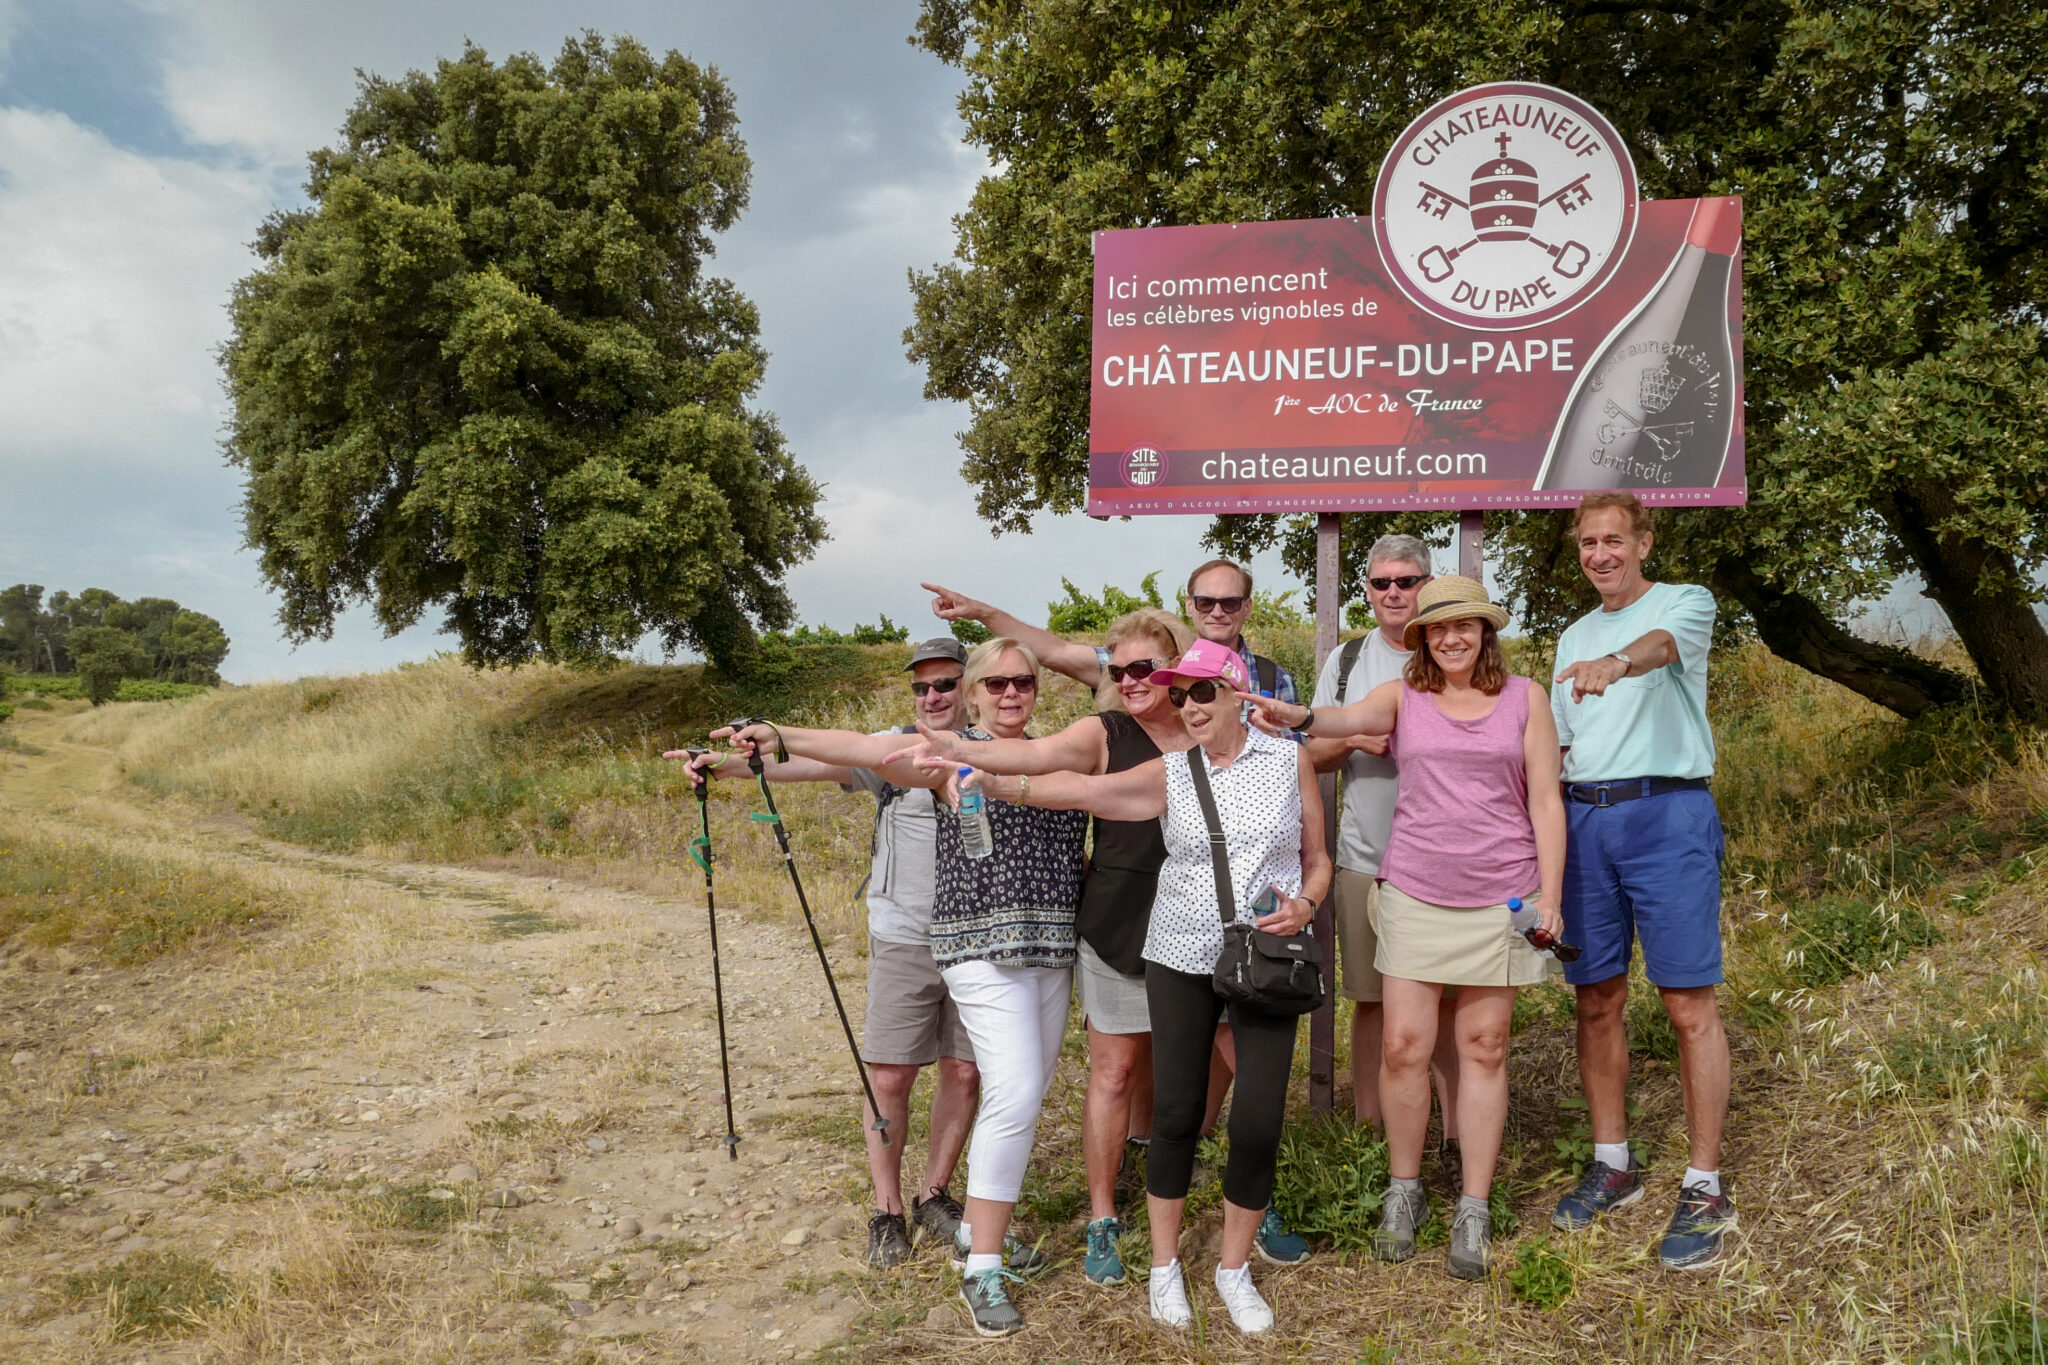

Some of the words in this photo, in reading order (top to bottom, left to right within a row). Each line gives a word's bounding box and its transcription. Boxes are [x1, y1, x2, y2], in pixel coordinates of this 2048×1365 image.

[1412, 103, 1601, 166] CHATEAUNEUF
[1108, 274, 1138, 300] Ici
[1147, 267, 1328, 298] commencent
[1450, 279, 1491, 310] DU
[1495, 275, 1557, 313] PAPE
[1107, 308, 1137, 327] les
[1143, 304, 1235, 325] célèbres
[1240, 299, 1345, 326] vignobles
[1351, 297, 1378, 317] de
[1102, 337, 1574, 387] CHÂTEAUNEUF-DU-PAPE
[1307, 393, 1373, 415] AOC
[1378, 393, 1399, 413] de
[1405, 389, 1483, 416] France
[1131, 448, 1158, 463] SITE
[1201, 447, 1487, 480] chateauneuf.com
[1182, 500, 1229, 508] ALCOOL
[1267, 499, 1342, 507] DANGEREUX
[1350, 497, 1383, 506] POUR
[1392, 497, 1407, 505] LA
[1415, 495, 1457, 505] SANTÉ
[1487, 494, 1570, 504] CONSOMMER
